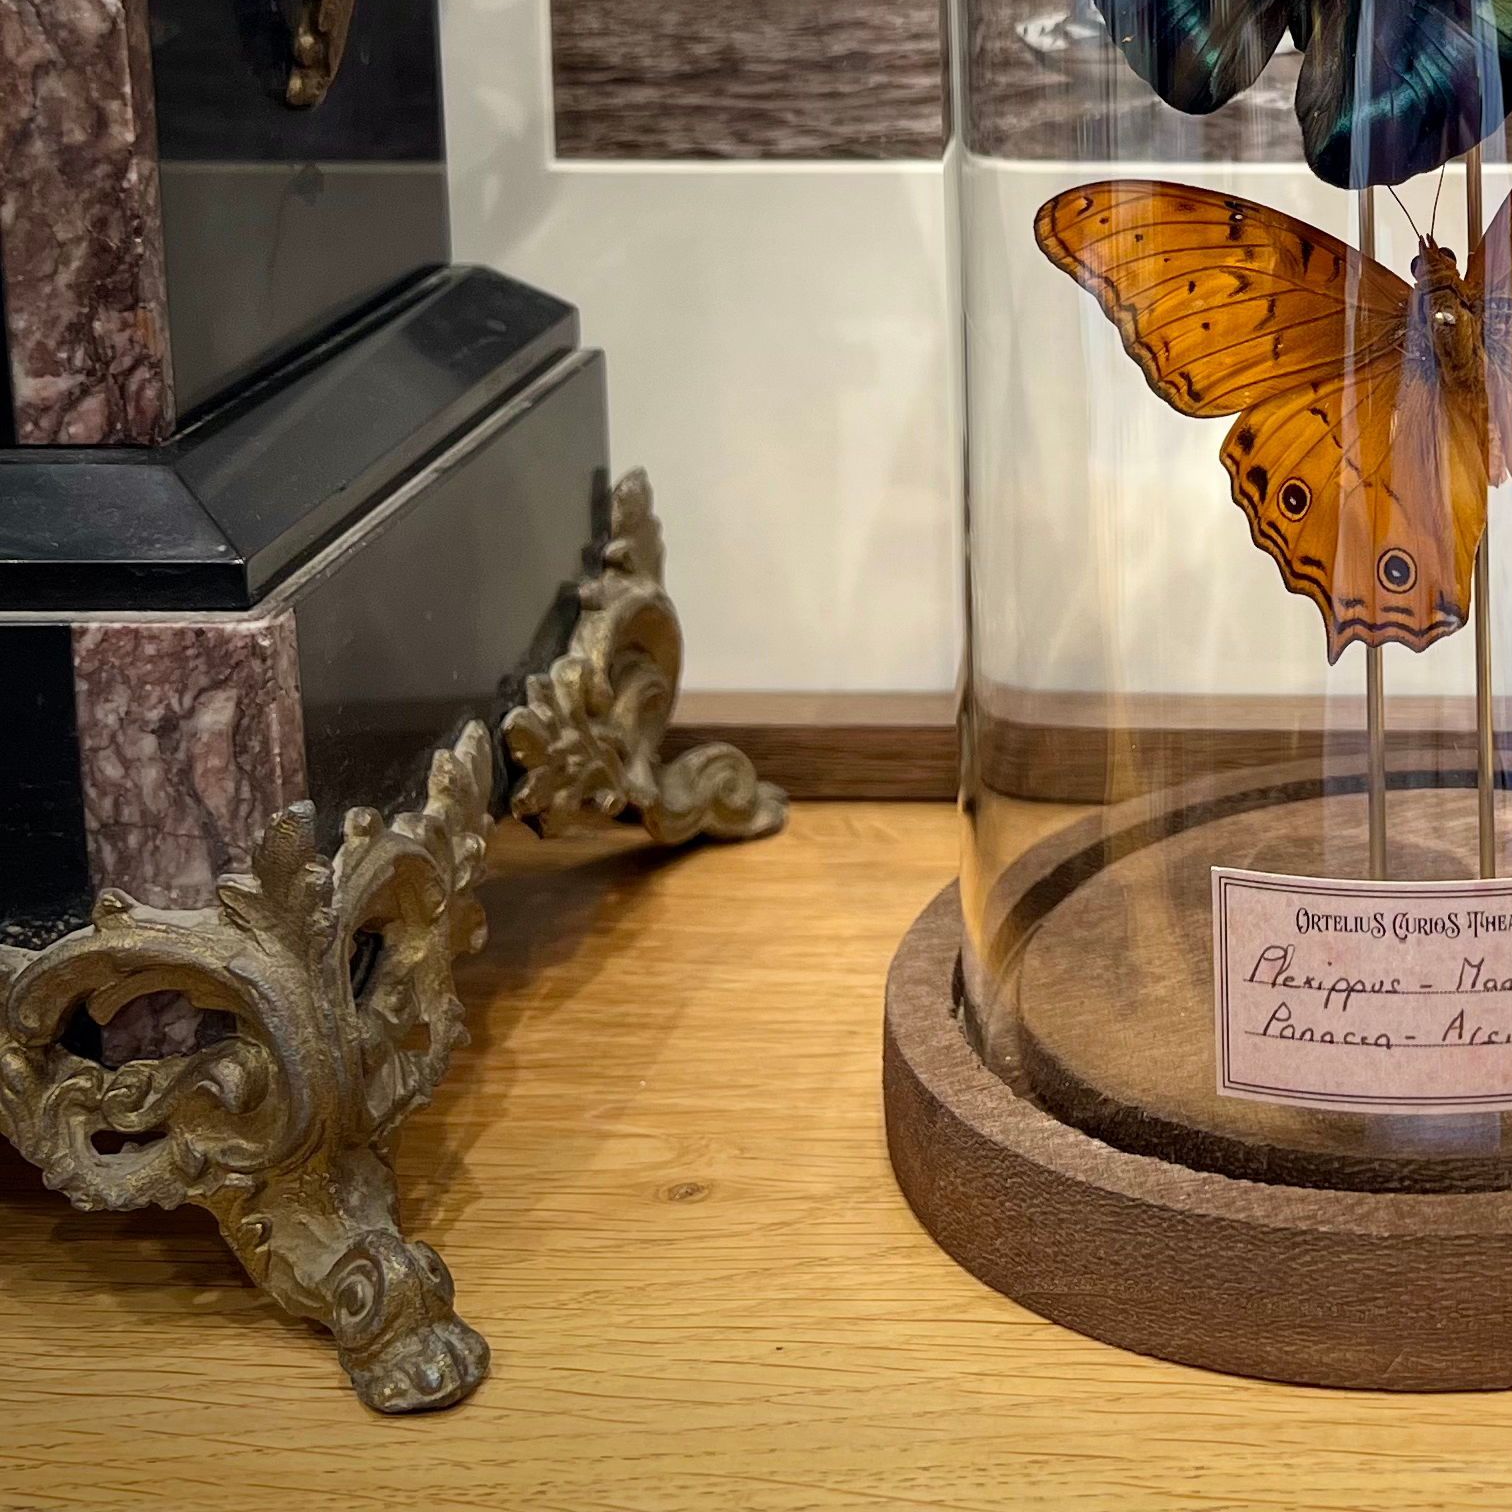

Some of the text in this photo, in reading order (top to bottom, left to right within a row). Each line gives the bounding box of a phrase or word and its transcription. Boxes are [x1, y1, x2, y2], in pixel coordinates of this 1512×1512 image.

[1296, 907, 1386, 939] ORTELIUS
[1392, 911, 1460, 940] CURIOS
[1249, 944, 1401, 1011] Plexippus
